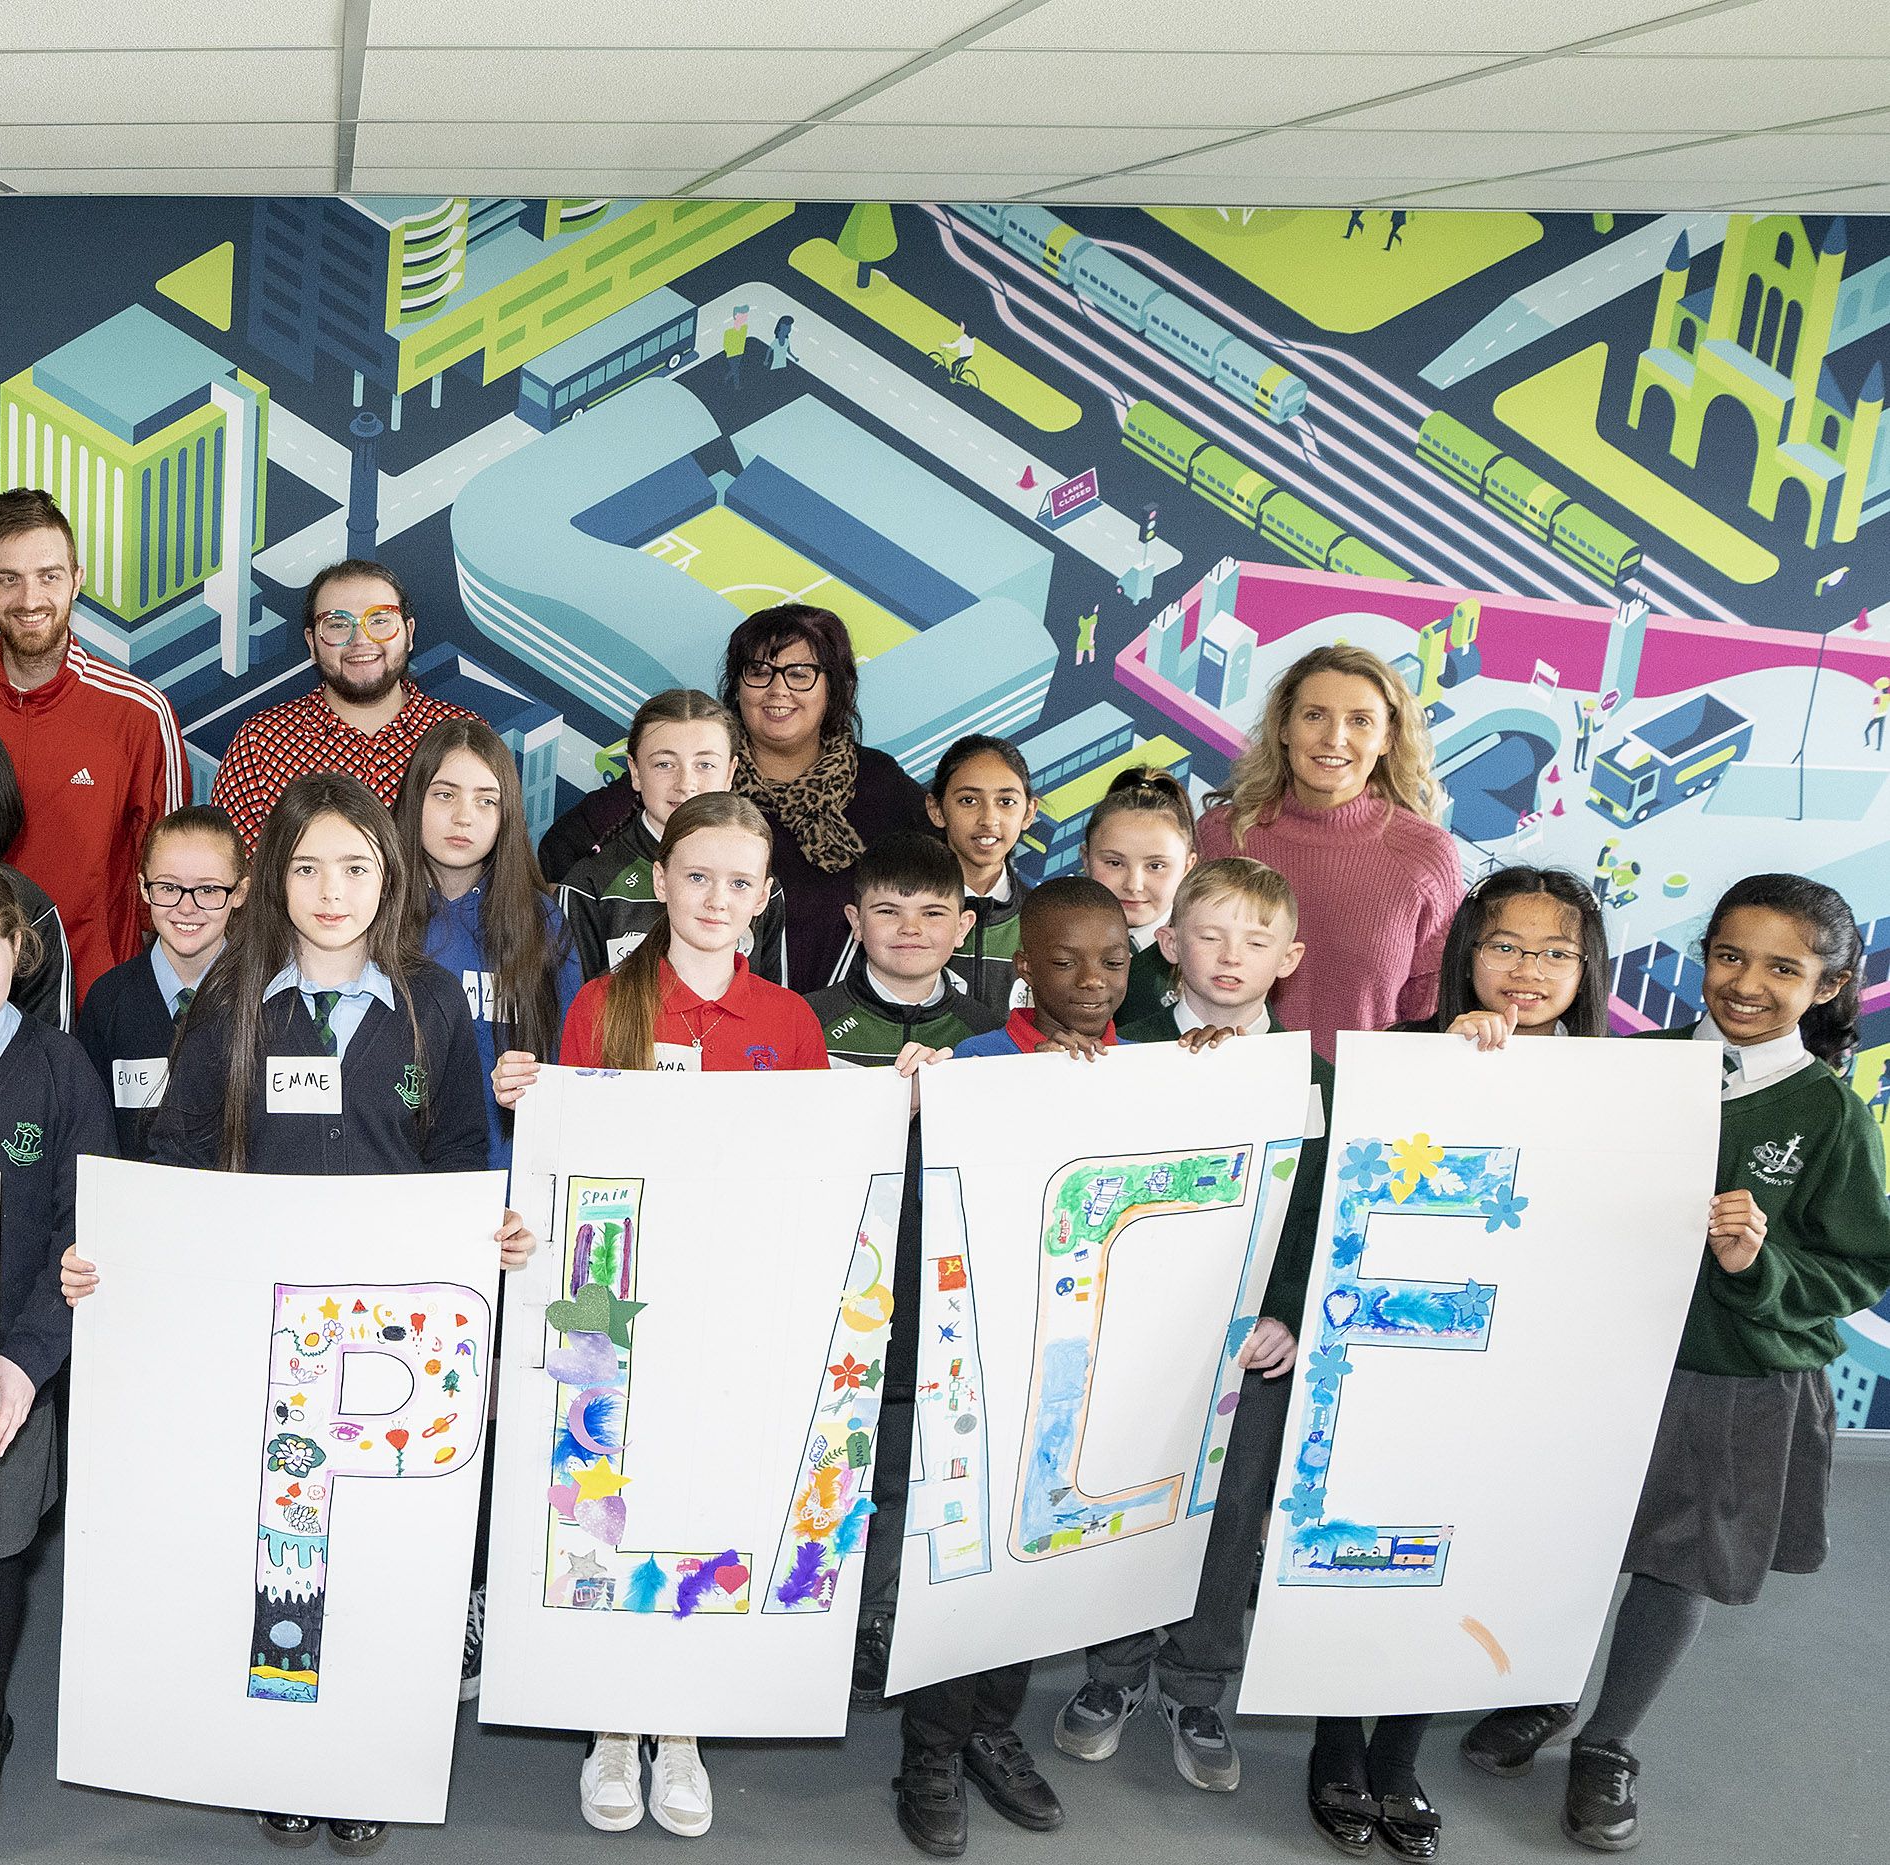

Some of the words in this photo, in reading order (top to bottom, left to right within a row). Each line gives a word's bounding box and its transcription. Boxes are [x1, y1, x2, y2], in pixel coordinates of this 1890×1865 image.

[1058, 486, 1092, 507] CLOSED
[1062, 481, 1085, 498] LANE
[70, 778, 95, 786] adidas
[625, 872, 641, 888] SF
[830, 1017, 859, 1040] DVM
[118, 1071, 149, 1086] EVIE
[272, 1072, 331, 1093] EMME
